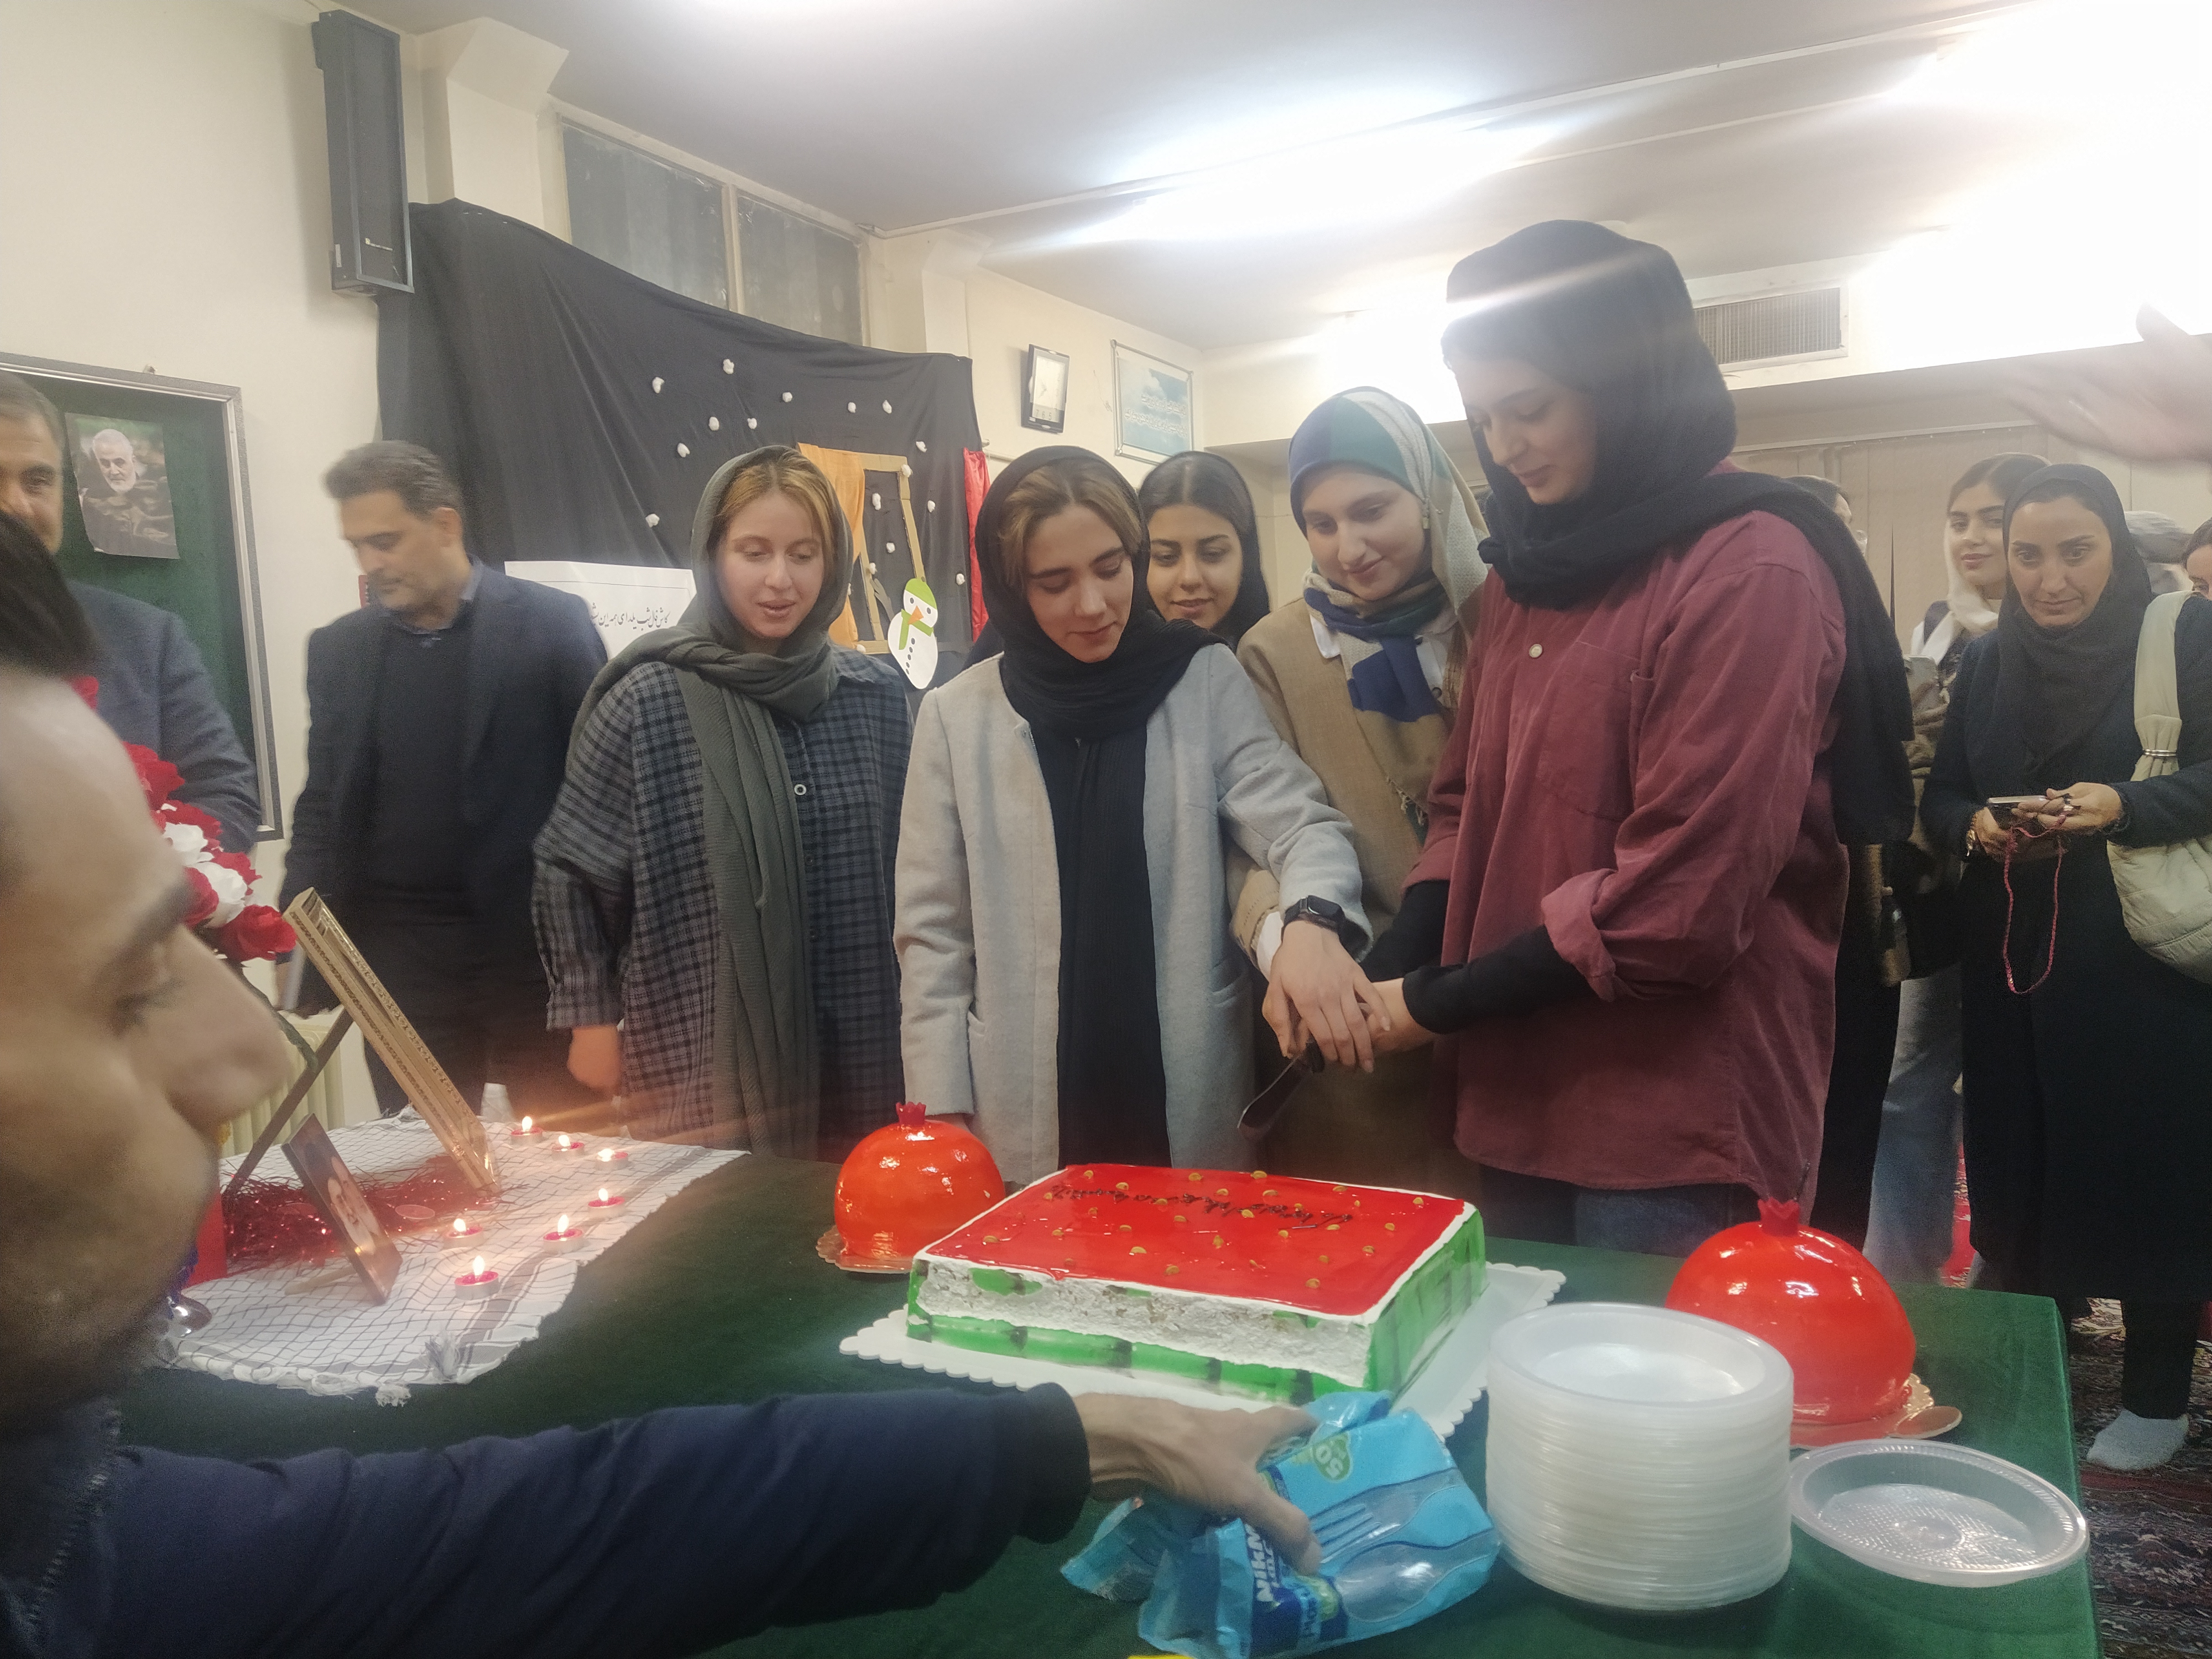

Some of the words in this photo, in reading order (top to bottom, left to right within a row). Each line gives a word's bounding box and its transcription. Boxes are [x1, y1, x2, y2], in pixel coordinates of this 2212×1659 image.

[1035, 409, 1039, 417] 7
[1048, 412, 1052, 420] 5
[598, 612, 609, 627] این
[617, 612, 637, 629] یلدای
[637, 607, 652, 631] شب
[648, 609, 658, 628] فال
[656, 607, 671, 628] کاش
[1316, 1444, 1343, 1478] 50
